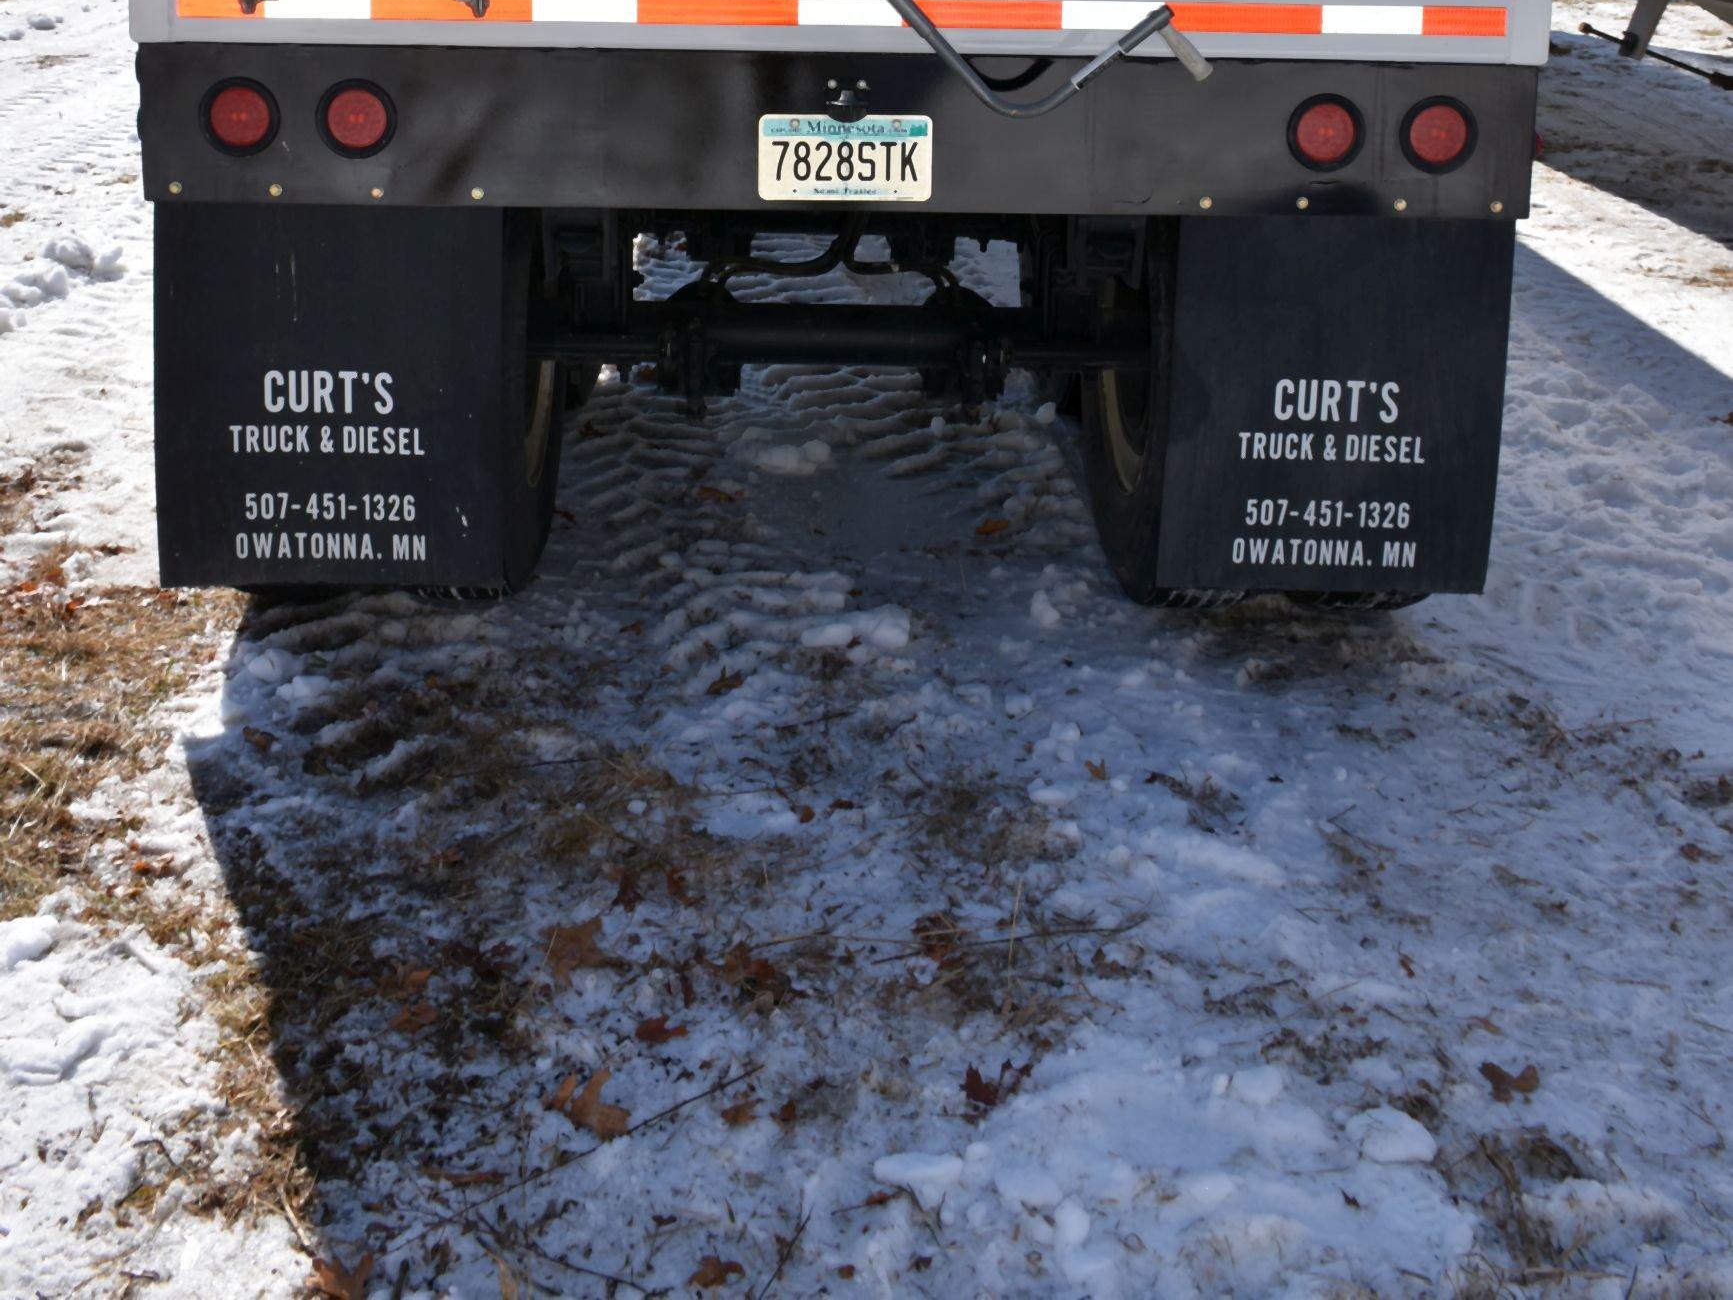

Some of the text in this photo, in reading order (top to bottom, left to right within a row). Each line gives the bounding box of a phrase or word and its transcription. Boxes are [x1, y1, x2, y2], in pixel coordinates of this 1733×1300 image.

[806, 120, 885, 134] Minnesota
[772, 141, 918, 181] 7828STK
[263, 369, 394, 415] CURT'S
[1274, 378, 1400, 424] CURT'S
[229, 424, 425, 455] TRUCK & DIESEL
[1239, 432, 1425, 464] TRUCK & DIESEL
[245, 492, 416, 521] 507-451-1326
[1245, 499, 1411, 528] 507-451-1326
[392, 534, 426, 562] MN
[1382, 541, 1417, 568] MN
